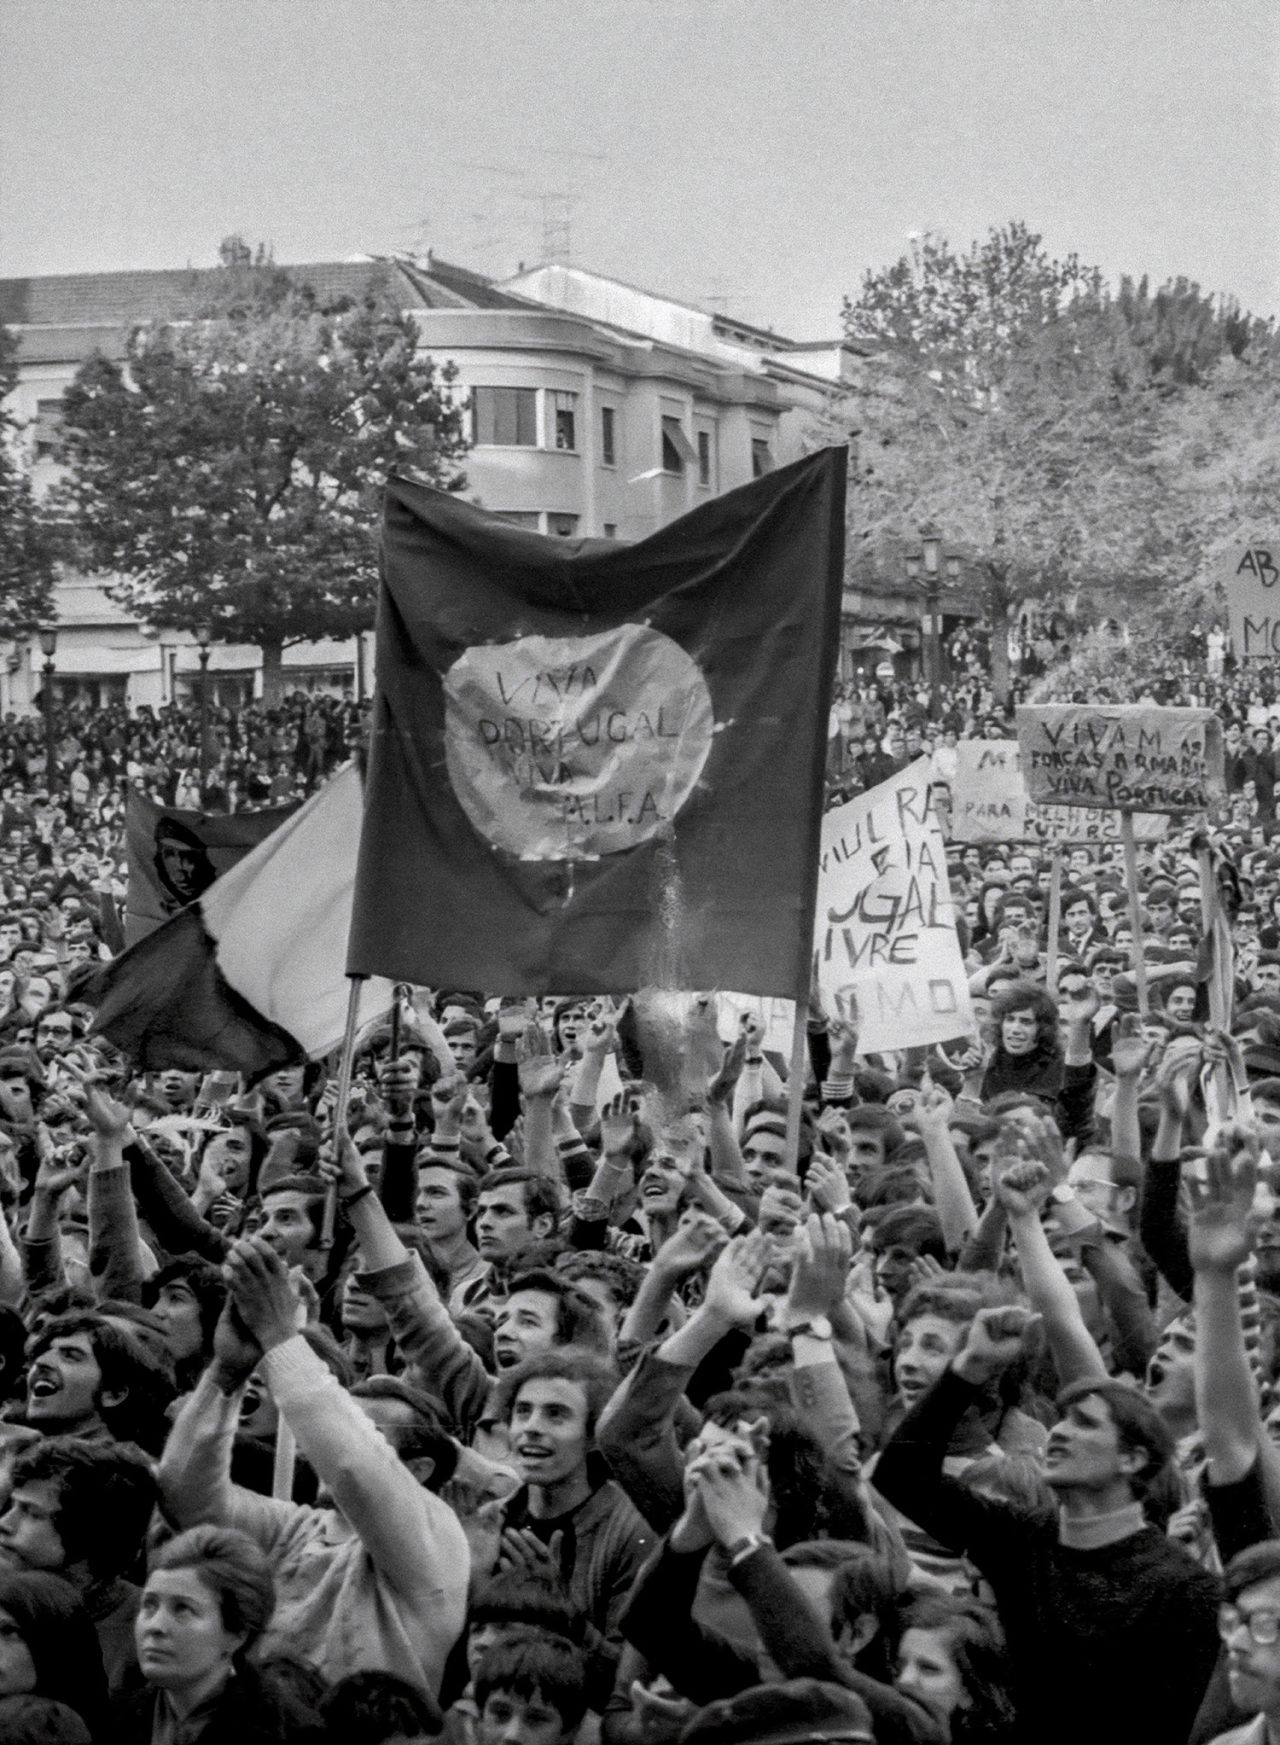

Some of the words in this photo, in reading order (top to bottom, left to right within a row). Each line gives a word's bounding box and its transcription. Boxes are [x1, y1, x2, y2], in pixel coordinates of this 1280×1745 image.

[495, 666, 597, 705] VIVA
[478, 706, 680, 761] PORTUGAL
[1041, 721, 1162, 755] VIVAM
